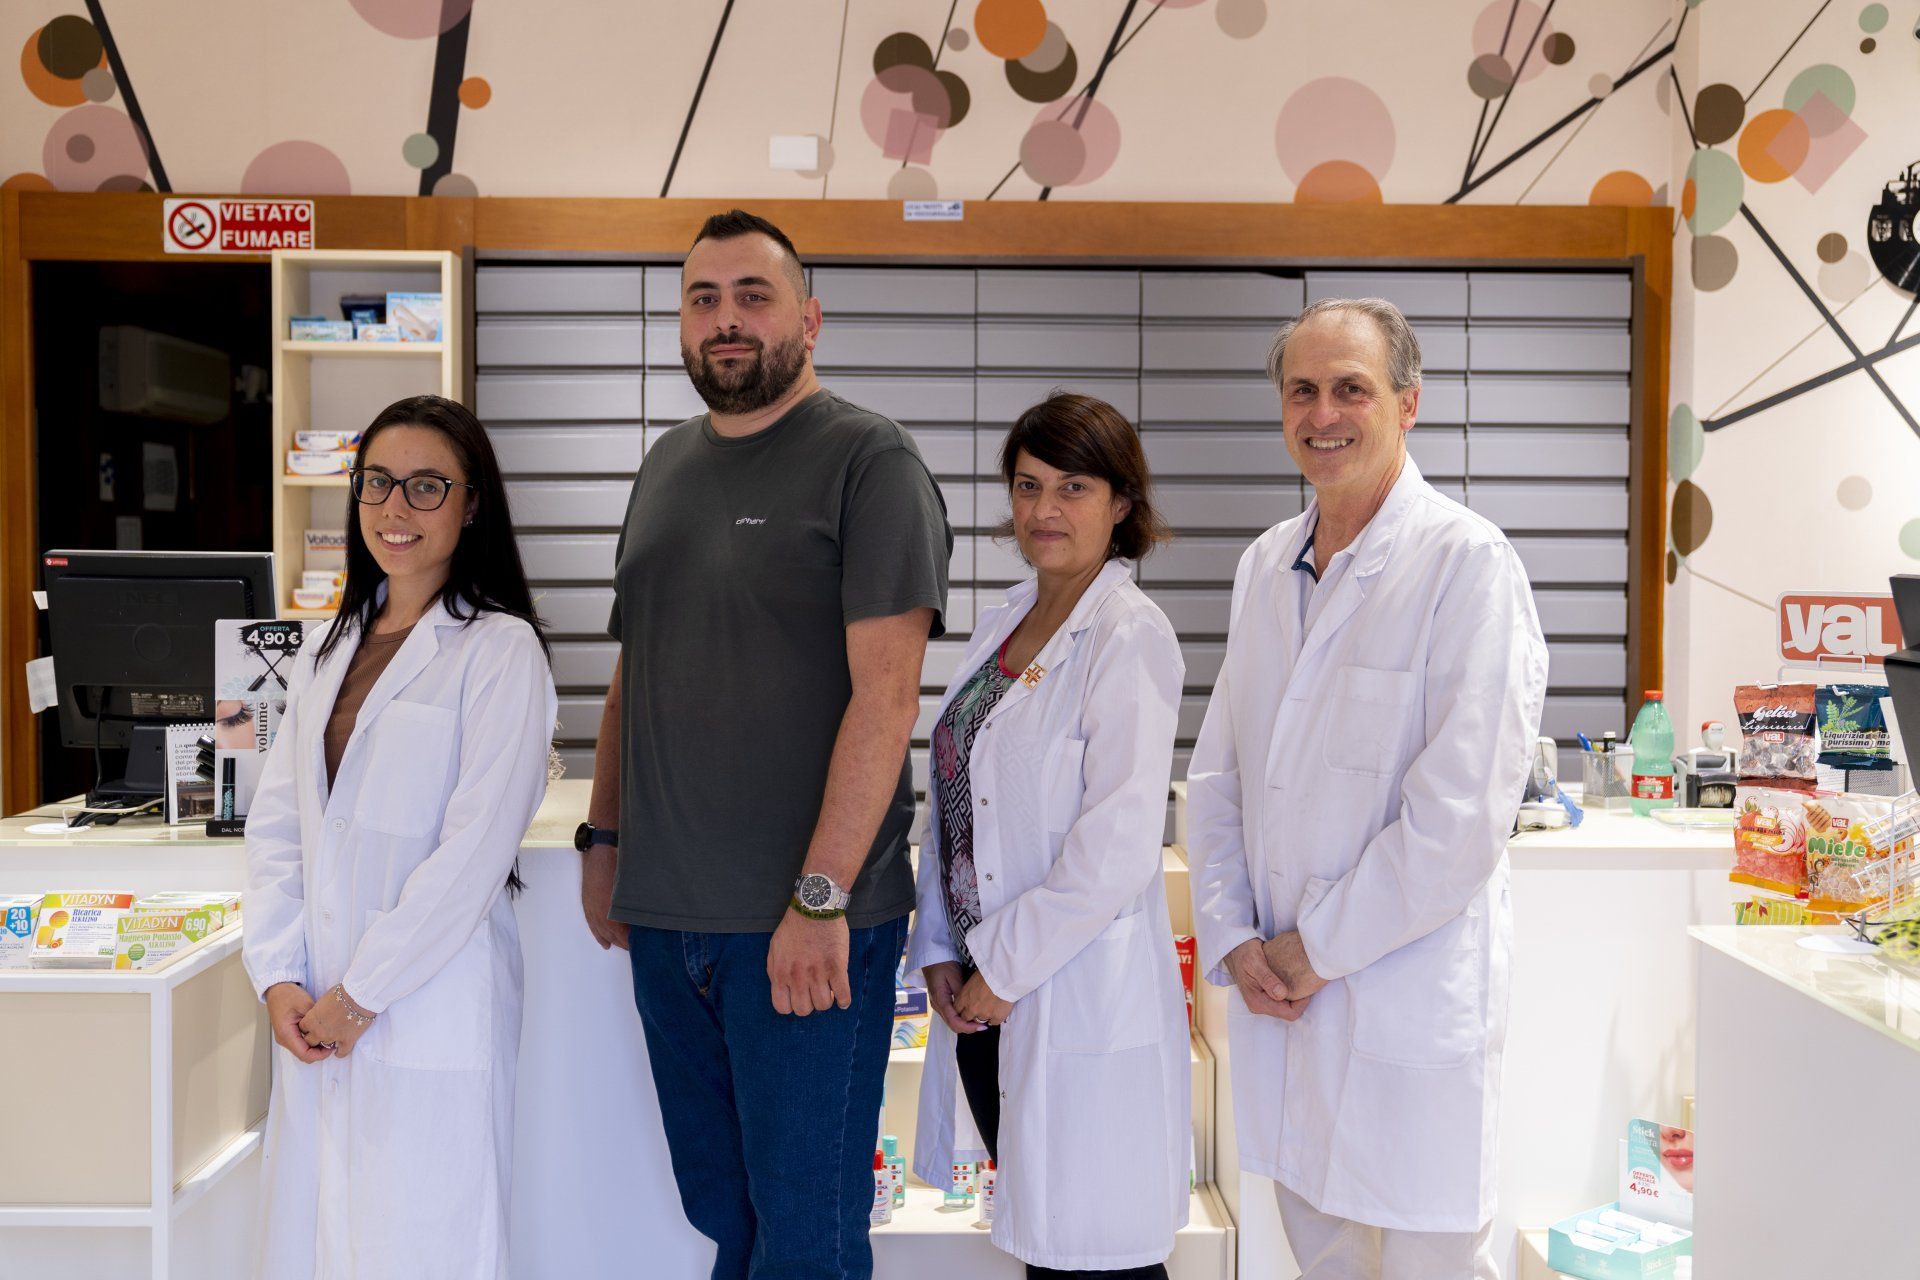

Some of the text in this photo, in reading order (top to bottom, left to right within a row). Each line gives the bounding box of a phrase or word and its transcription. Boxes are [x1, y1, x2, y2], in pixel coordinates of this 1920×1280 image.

[221, 203, 311, 222] VIETATO
[222, 230, 311, 248] FUMARE
[247, 630, 285, 648] 4,90
[256, 702, 268, 754] volume
[1740, 721, 1807, 735] Liquirizia
[1823, 731, 1865, 740] Liquirizia
[1827, 739, 1870, 747] purissima
[1808, 837, 1866, 858] Miele
[60, 895, 116, 907] VITADYN
[11, 908, 27, 920] 20
[73, 909, 102, 917] Ricarica
[10, 921, 29, 931] +10
[121, 917, 178, 932] VITADYN
[1631, 1124, 1656, 1138] Stick
